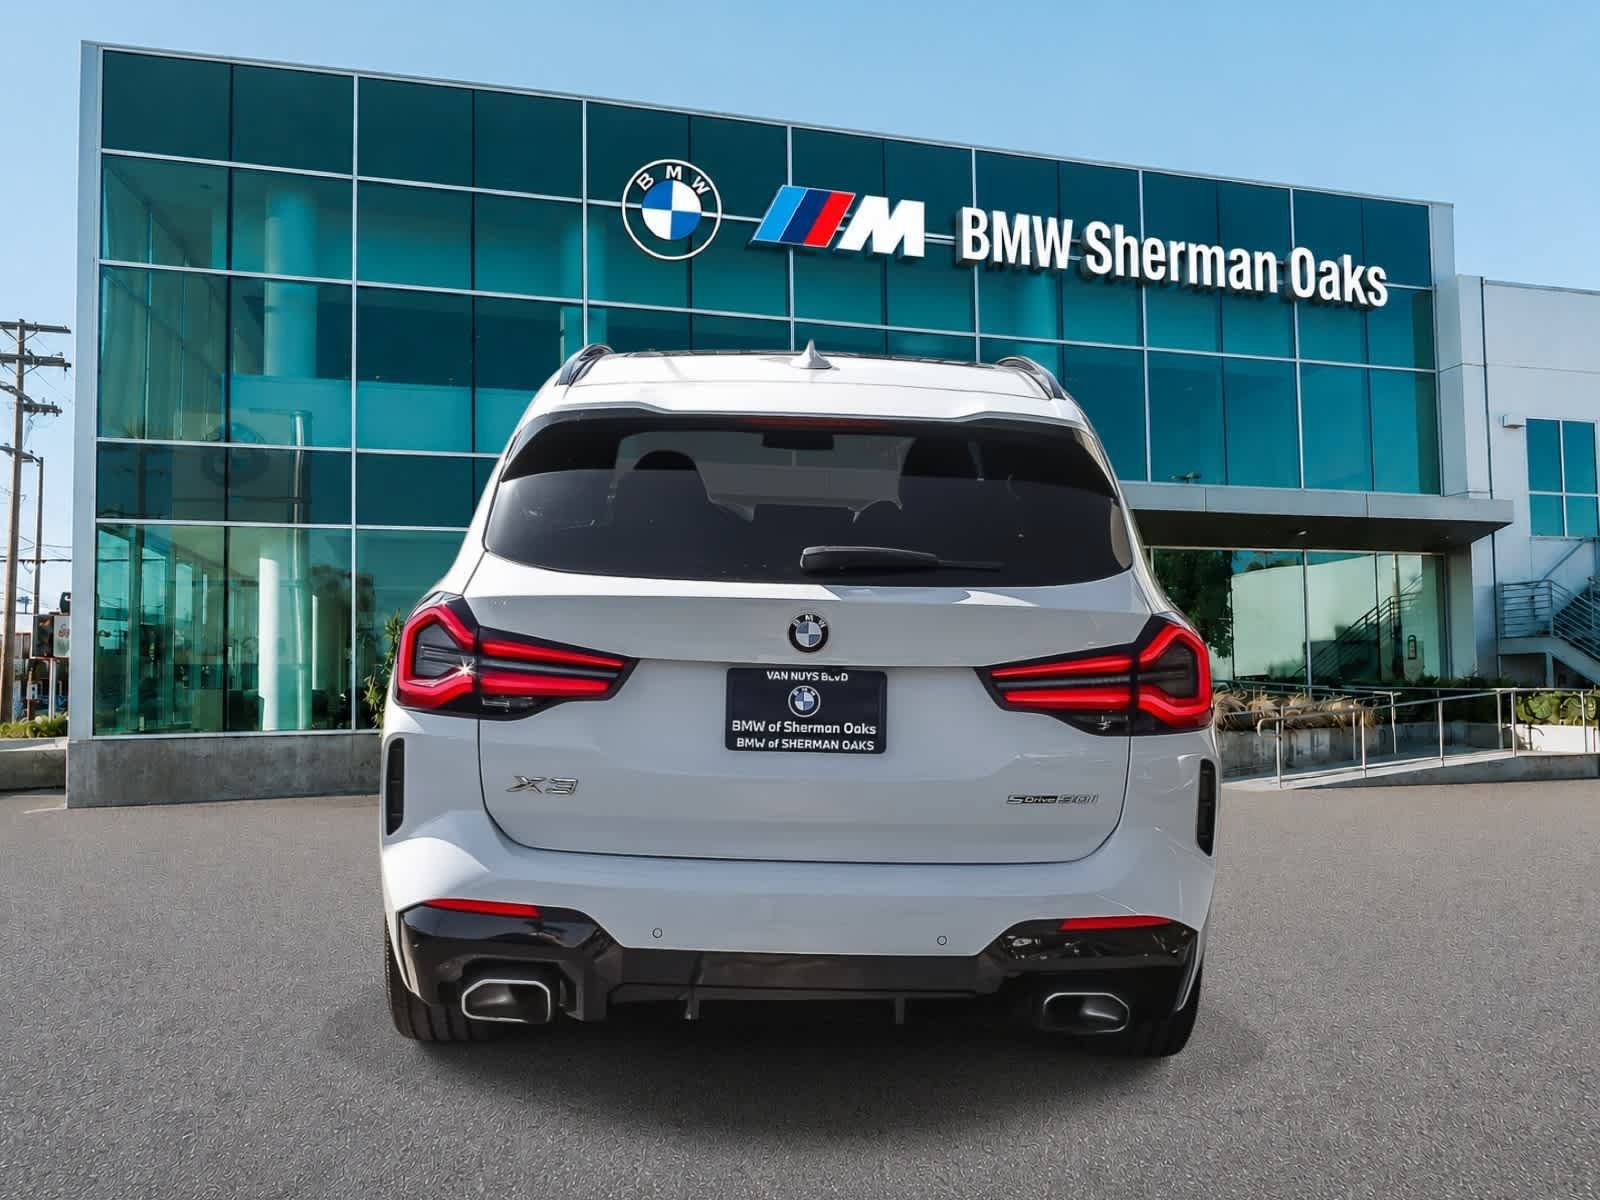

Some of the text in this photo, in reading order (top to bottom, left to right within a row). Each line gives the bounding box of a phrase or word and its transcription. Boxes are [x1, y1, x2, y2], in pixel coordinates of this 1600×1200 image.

[636, 165, 711, 195] BMW
[961, 206, 1388, 308] BMW Sherman Oaks
[766, 671, 788, 681] VAN
[790, 671, 819, 682] NUYS
[732, 720, 876, 735] BMW of Sherman Oaks
[736, 737, 875, 750] BMW of SHERMAN OAKS
[506, 776, 578, 796] X3
